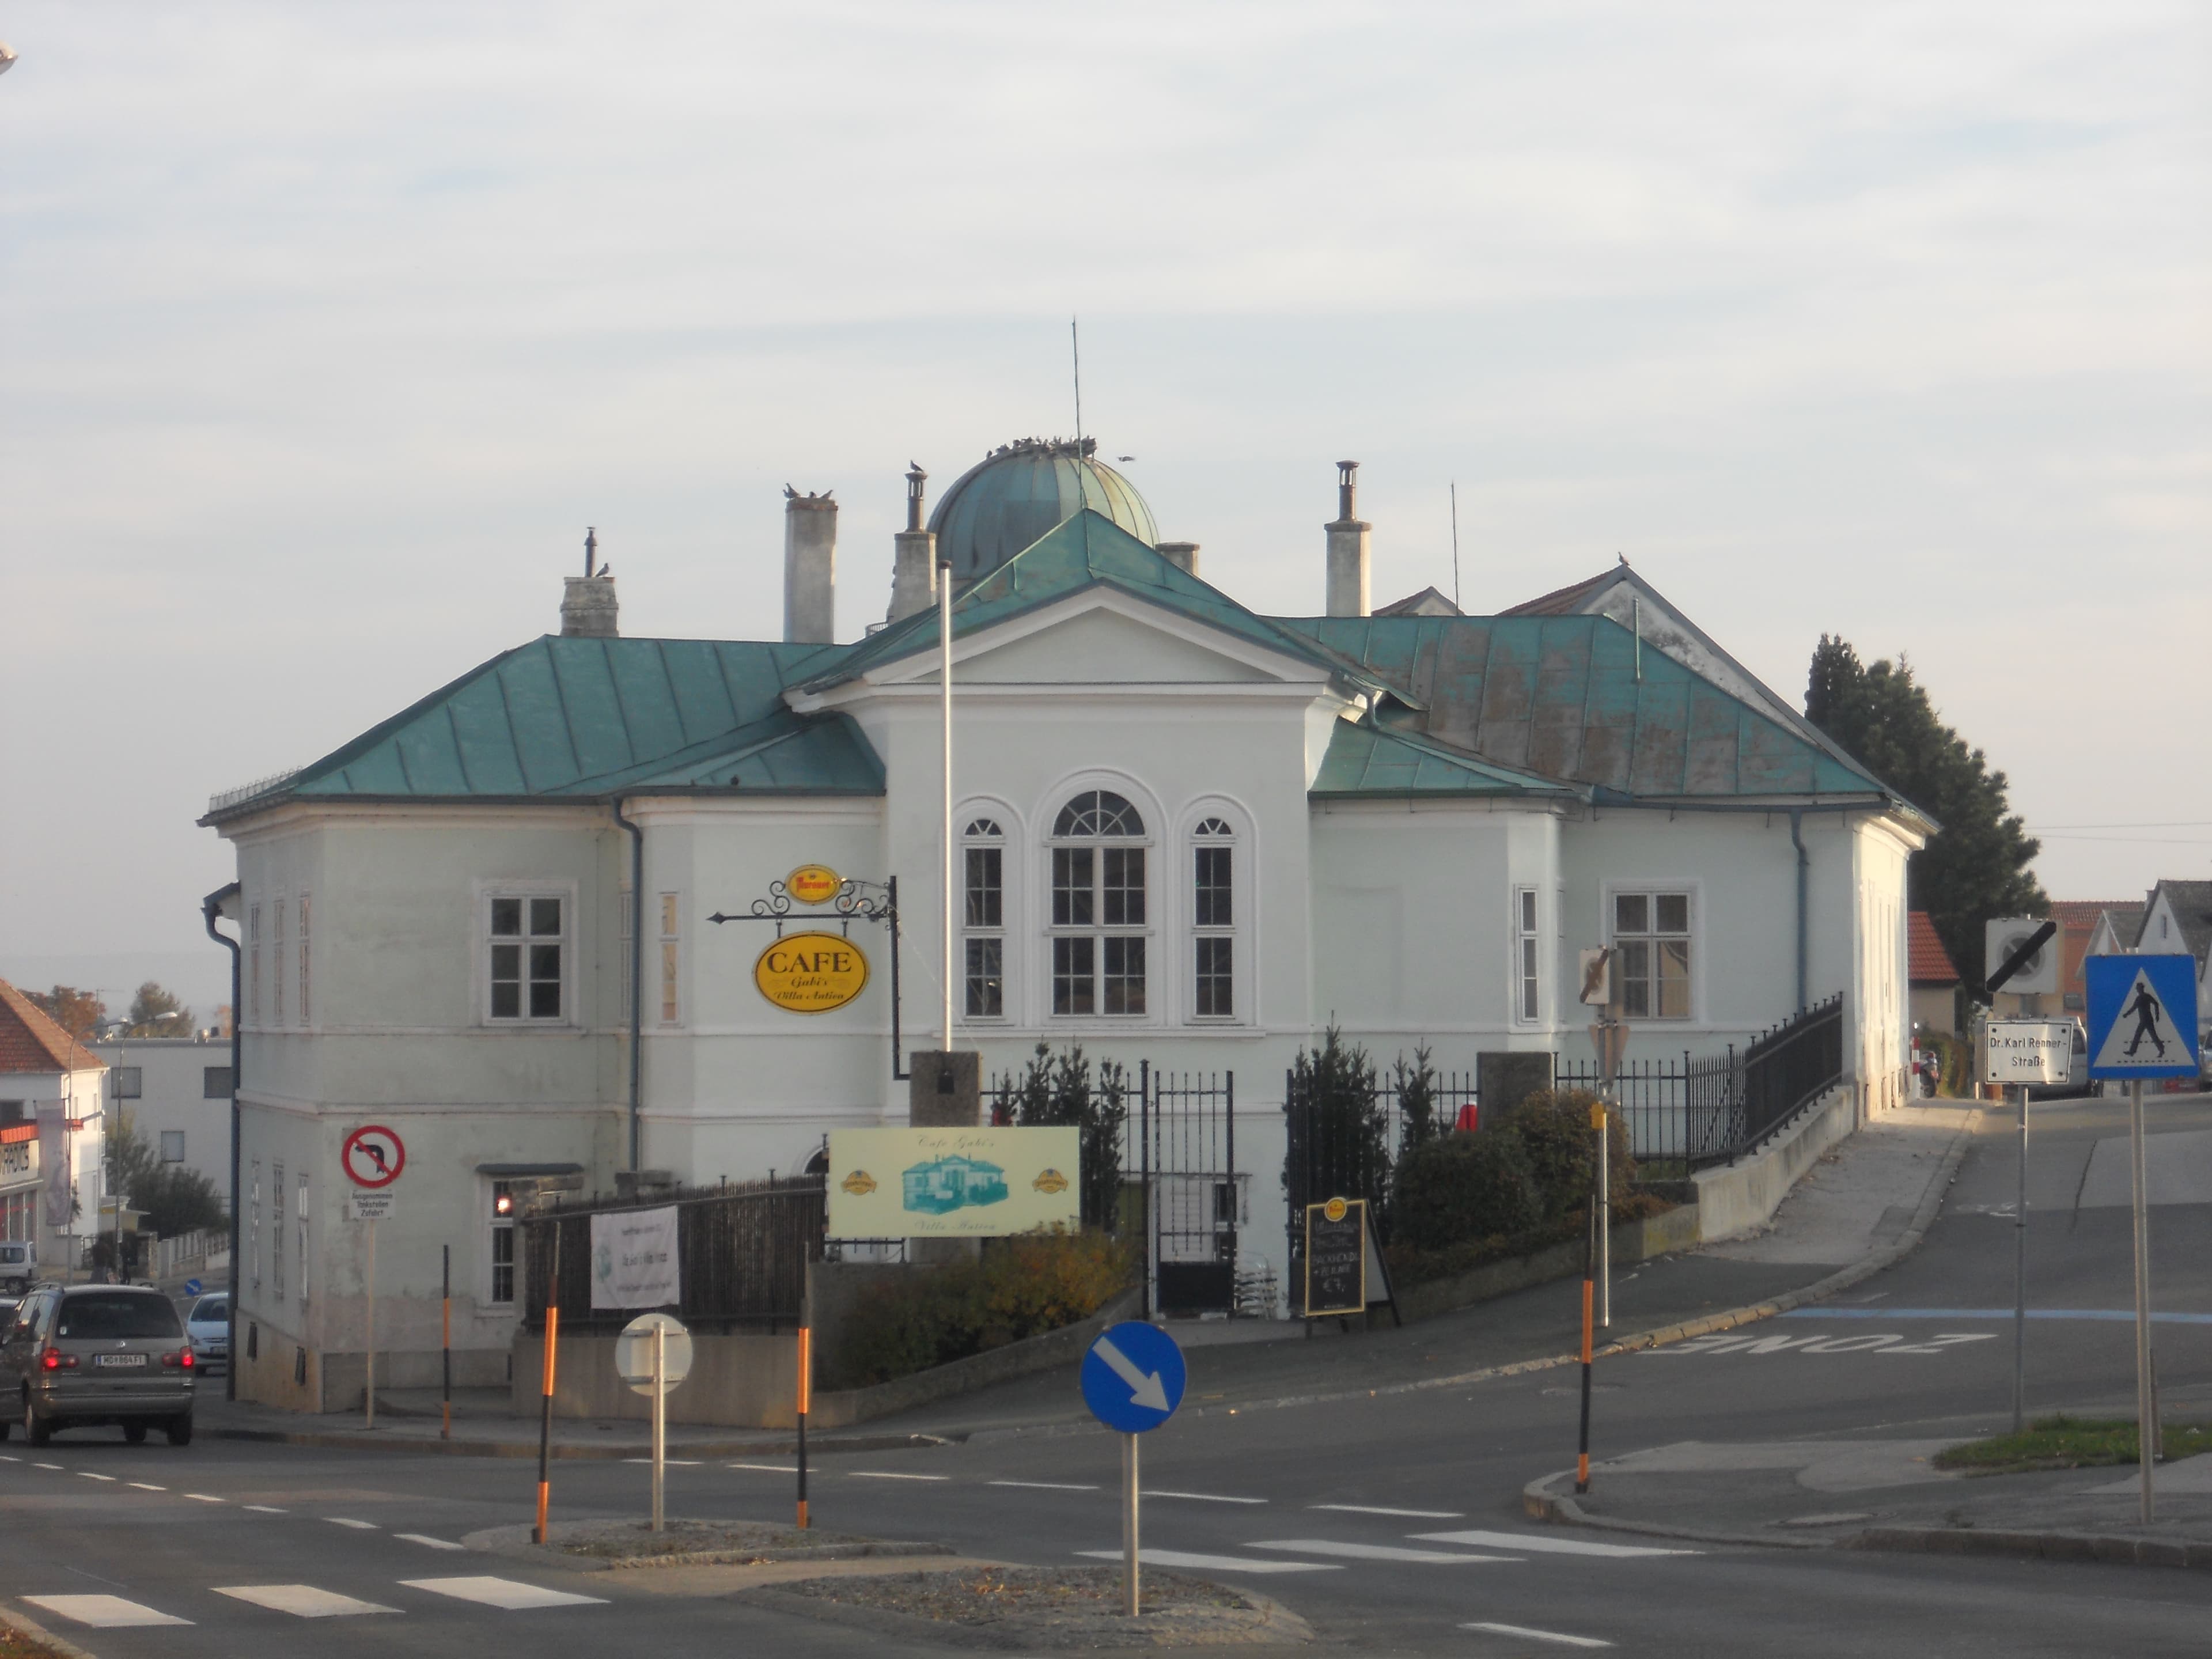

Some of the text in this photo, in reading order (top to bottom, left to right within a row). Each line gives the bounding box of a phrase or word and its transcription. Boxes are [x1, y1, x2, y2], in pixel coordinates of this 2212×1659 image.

[767, 952, 852, 974] CAFE
[774, 990, 804, 1001] Villa
[1990, 1037, 2067, 1048] Dr. Karl Renner-
[2012, 1056, 2046, 1067] Straße
[361, 1209, 384, 1217] Zufahrt
[1635, 1334, 1999, 1354] ZONE
